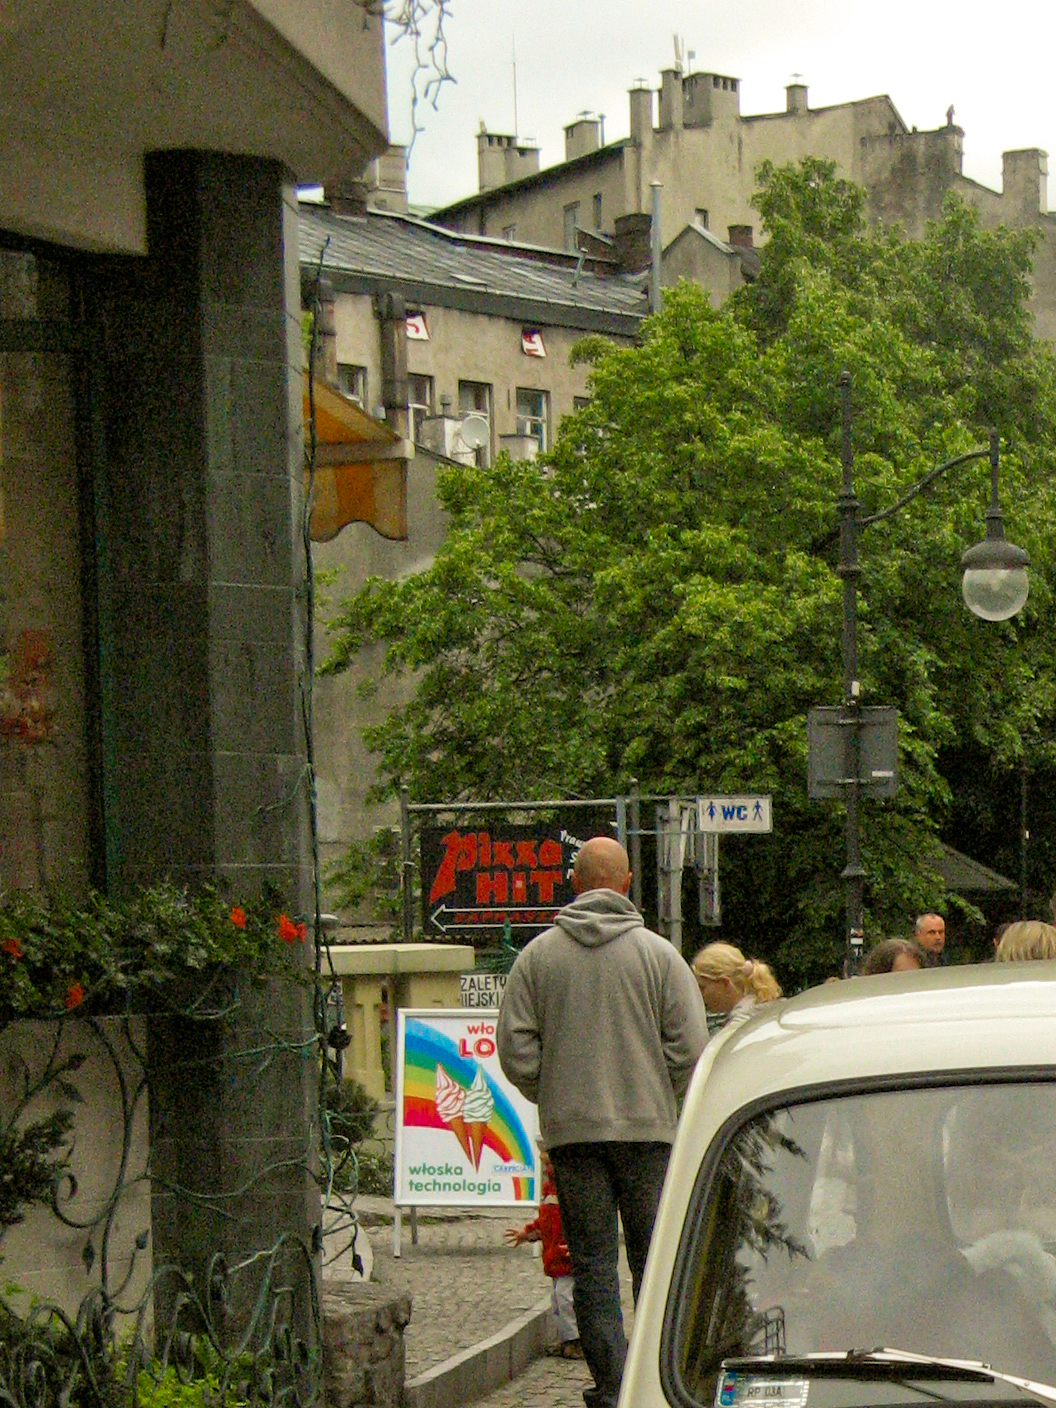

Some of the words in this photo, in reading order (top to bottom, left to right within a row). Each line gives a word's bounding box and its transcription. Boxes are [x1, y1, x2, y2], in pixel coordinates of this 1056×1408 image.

[721, 805, 748, 821] WC
[429, 830, 563, 904] Pizza
[475, 871, 563, 904] HIT
[408, 1163, 463, 1176] włoska
[408, 1180, 502, 1195] technologia
